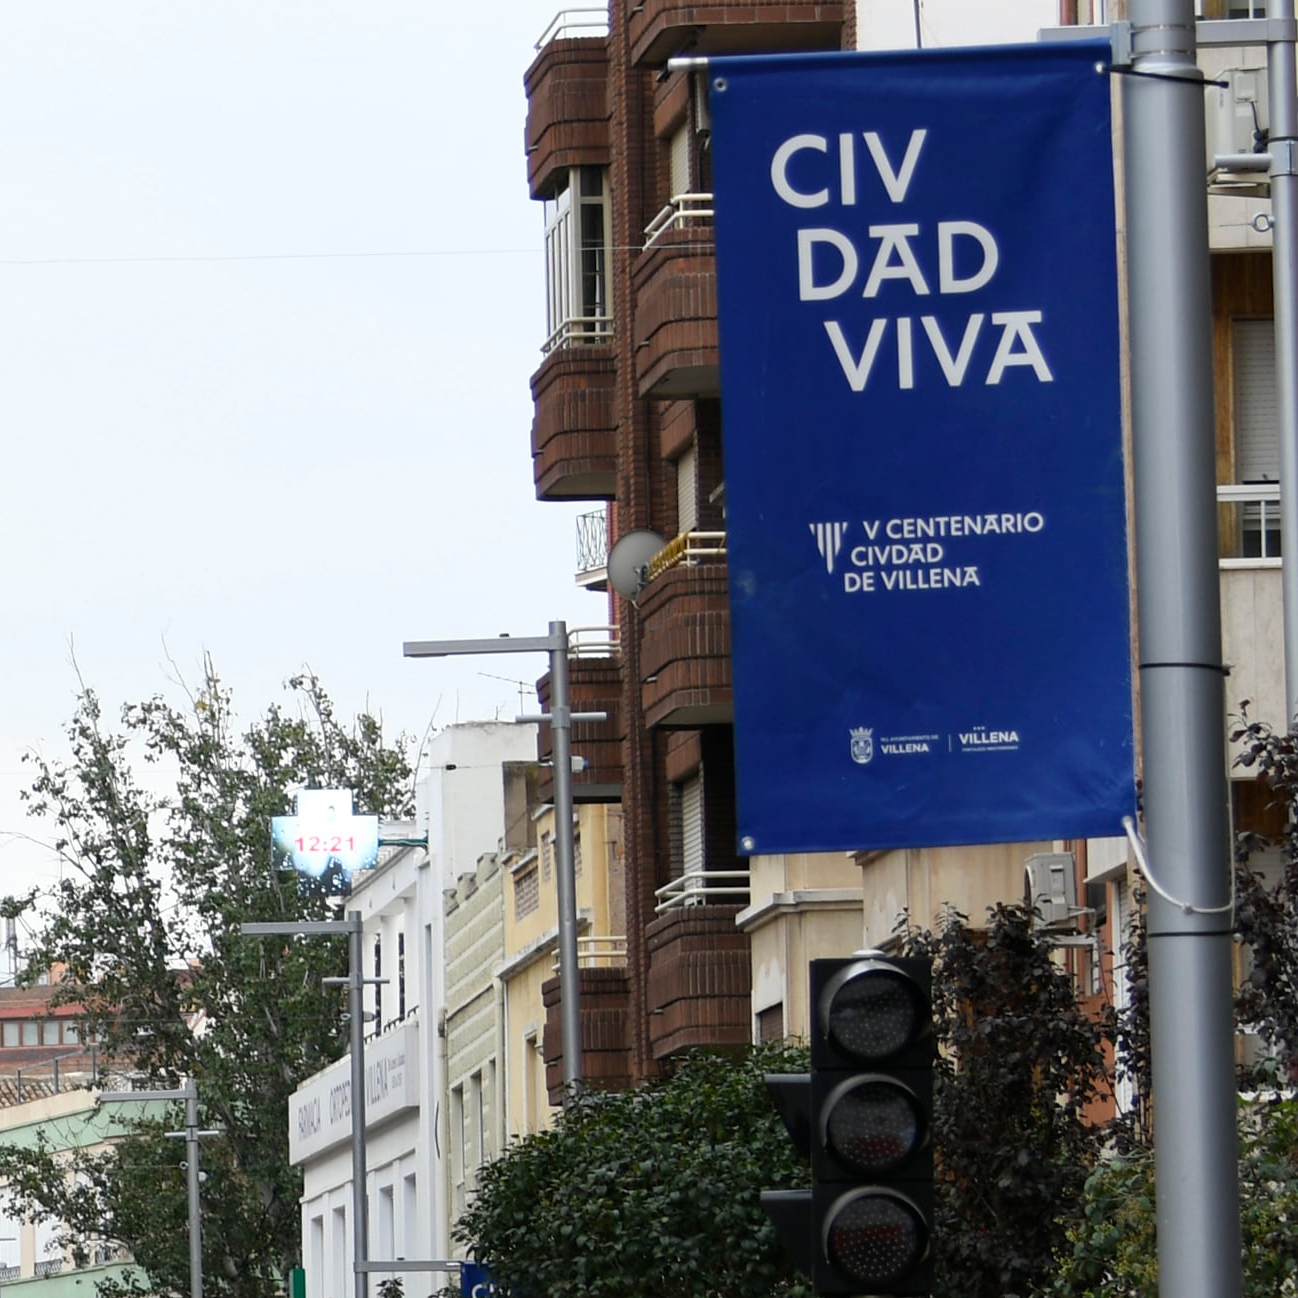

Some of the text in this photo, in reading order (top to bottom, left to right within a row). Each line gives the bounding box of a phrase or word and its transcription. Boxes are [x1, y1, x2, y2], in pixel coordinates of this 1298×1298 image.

[771, 129, 927, 208] CIV
[797, 221, 999, 301] DAD
[823, 310, 1054, 392] VIVA
[862, 512, 1044, 540] V CENTENARIO
[851, 543, 943, 566] CIVDAD
[844, 566, 981, 592] DE VILLENA
[881, 743, 929, 754] VILLENA
[959, 731, 1019, 744] VILLENA
[294, 836, 354, 852] 12:21
